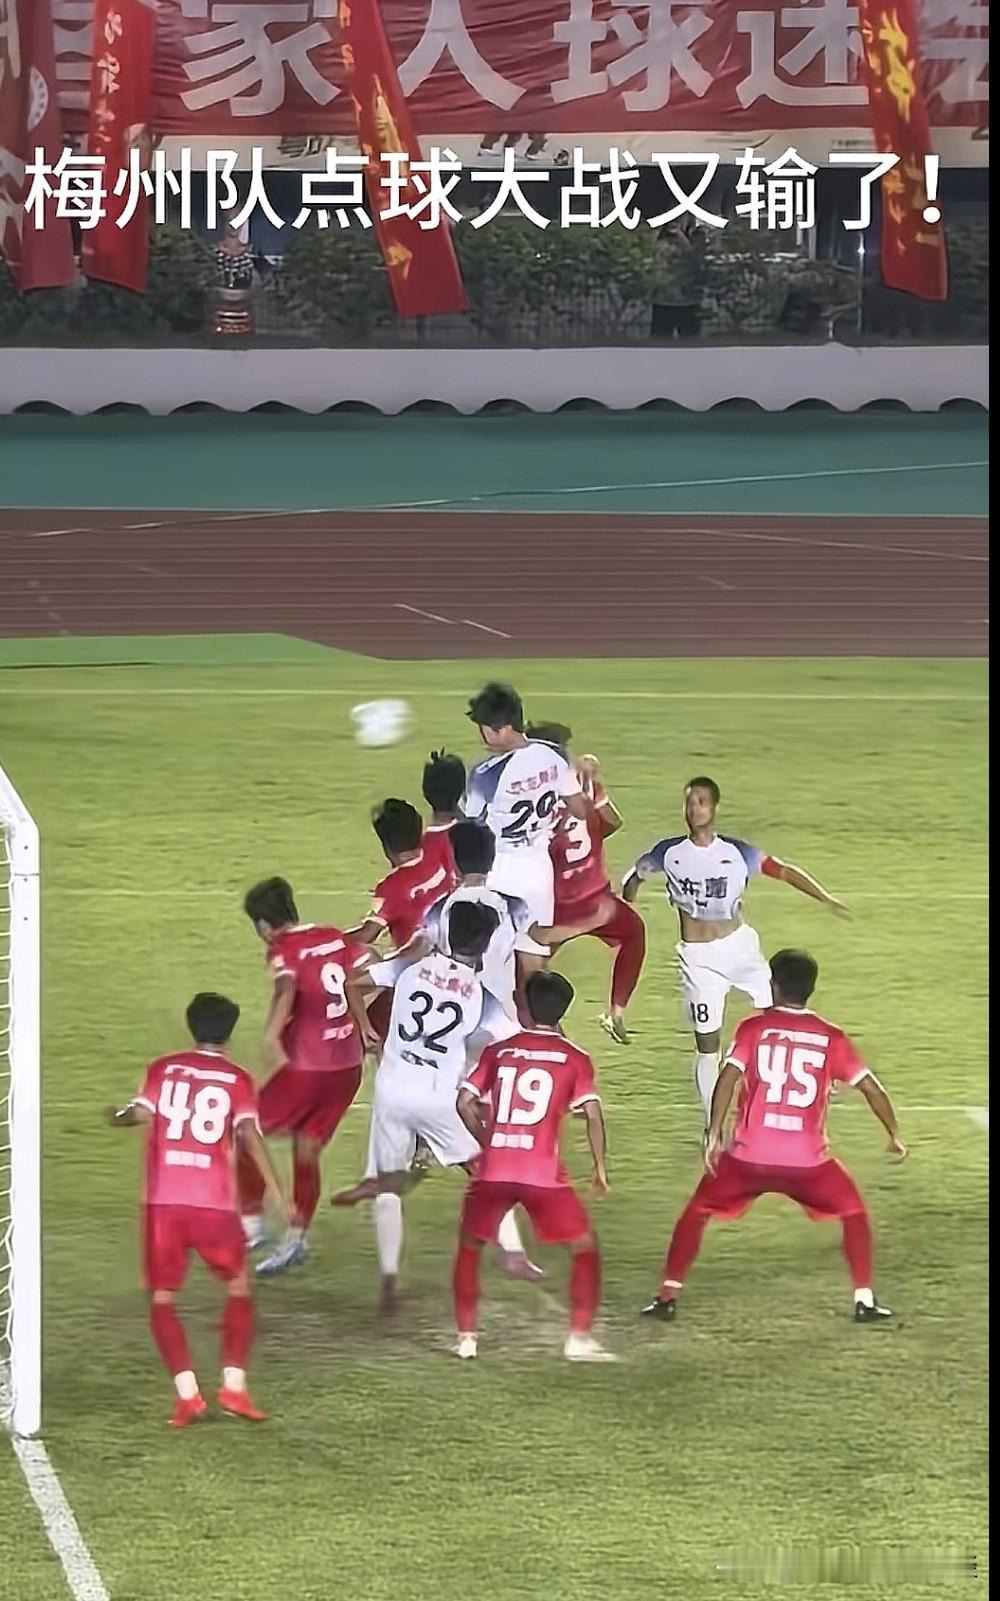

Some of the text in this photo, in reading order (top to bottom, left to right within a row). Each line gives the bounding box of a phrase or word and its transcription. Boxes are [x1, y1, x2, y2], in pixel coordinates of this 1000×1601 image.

[320, 961, 348, 1019] 9
[398, 990, 464, 1054] 32
[496, 1065, 554, 1126] 19
[757, 1043, 826, 1108] 45
[157, 1079, 231, 1145] 48
